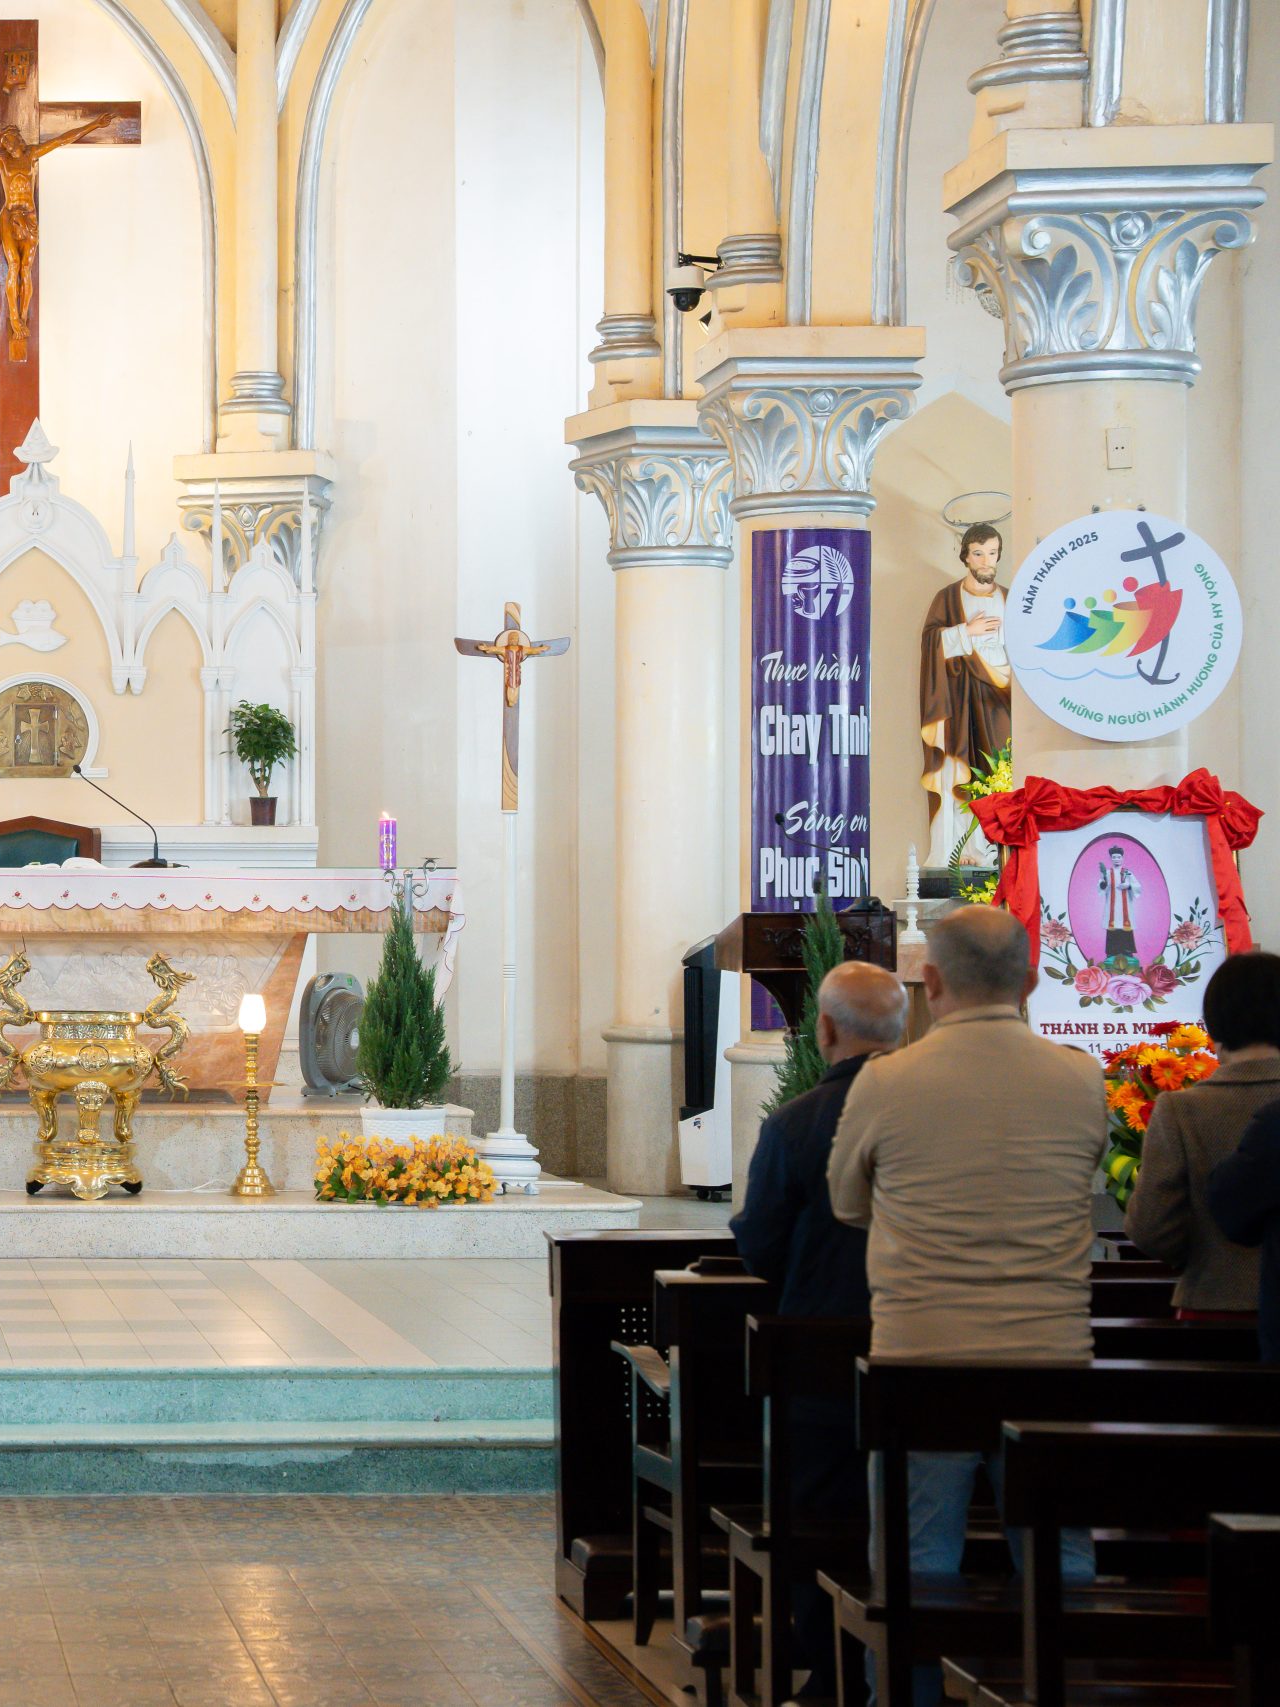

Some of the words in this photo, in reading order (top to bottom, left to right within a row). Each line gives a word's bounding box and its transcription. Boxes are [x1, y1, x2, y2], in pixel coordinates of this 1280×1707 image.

[1022, 585, 1039, 614] NĂM
[1033, 547, 1068, 583] THÁNH
[1069, 532, 1099, 551] 2025
[1194, 564, 1218, 599] VỌNG
[1211, 603, 1223, 618] HY
[1209, 623, 1223, 649] CỦA
[761, 651, 810, 686] Thực
[813, 653, 861, 682] hành
[1187, 653, 1218, 695] HƯƠNG
[1059, 697, 1104, 723] NHỮNG
[1108, 711, 1151, 725] NGƯỜI
[1153, 693, 1188, 718] HÀNH
[760, 705, 822, 765] Chay
[829, 704, 868, 767] Tịnh
[785, 801, 847, 843] Sống
[760, 847, 820, 910] Phục
[827, 846, 868, 898] Sinh
[1040, 1020, 1099, 1034] THÁNH
[1104, 1023, 1128, 1034] ĐA
[1088, 1043, 1101, 1053] 11
